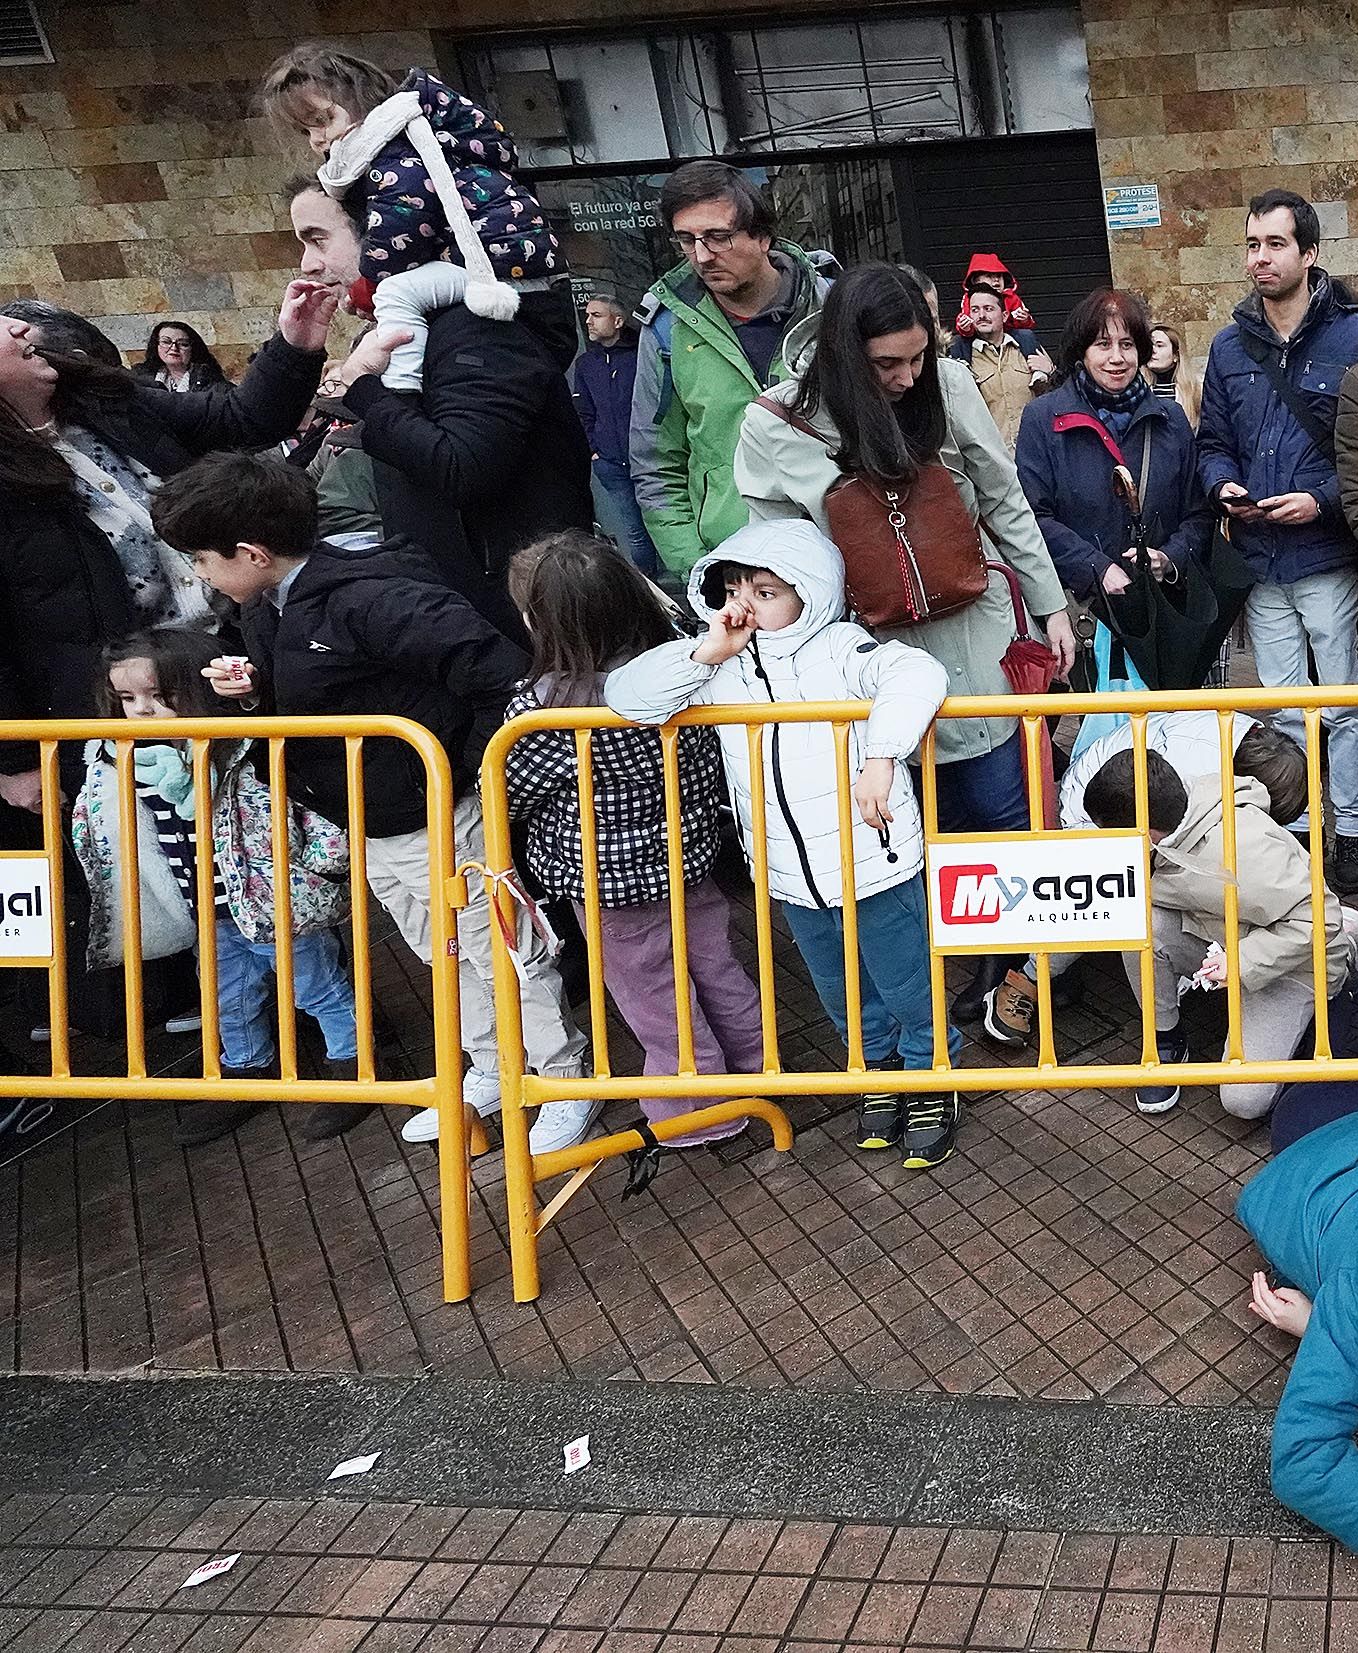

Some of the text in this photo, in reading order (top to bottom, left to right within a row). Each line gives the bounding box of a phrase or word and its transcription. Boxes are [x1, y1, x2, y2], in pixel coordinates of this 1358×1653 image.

[570, 199, 662, 215] El futuro ya es
[574, 215, 657, 232] con la red 5G
[1027, 911, 1111, 924] ALQUILER
